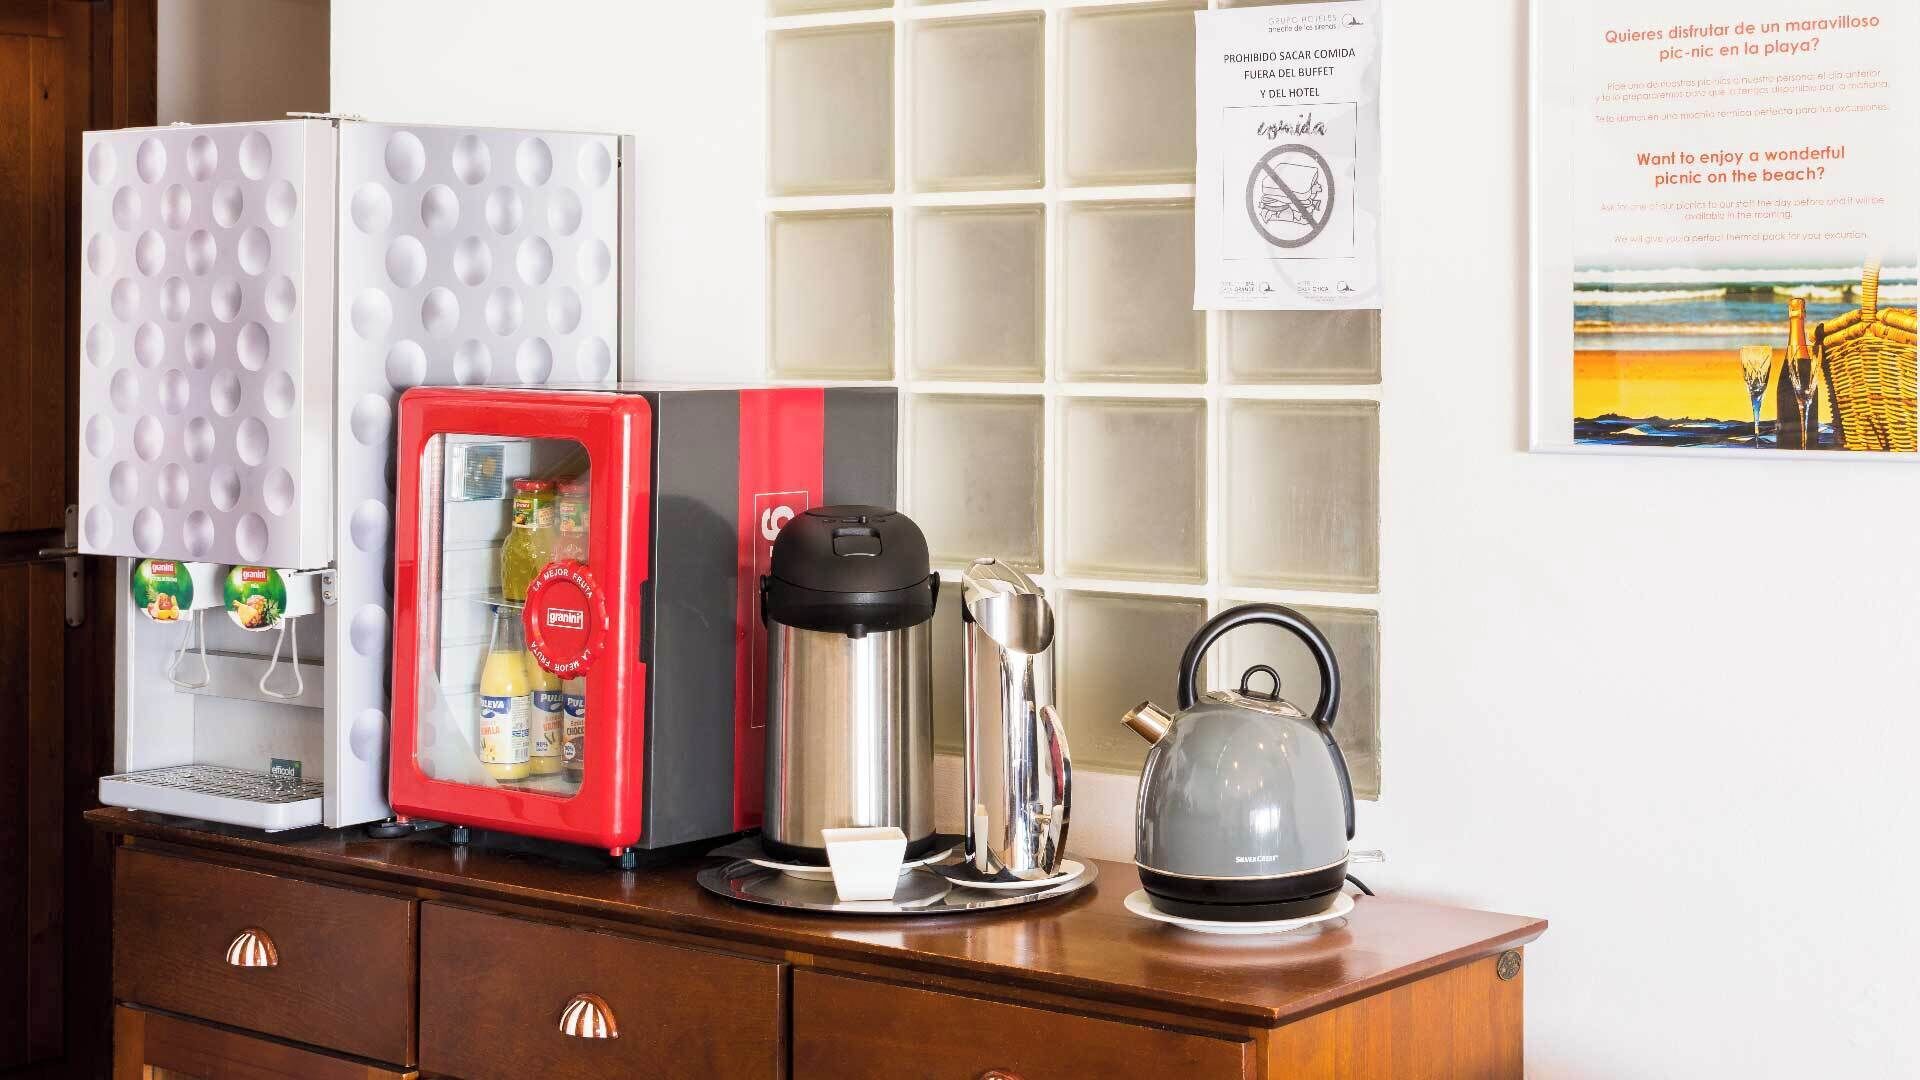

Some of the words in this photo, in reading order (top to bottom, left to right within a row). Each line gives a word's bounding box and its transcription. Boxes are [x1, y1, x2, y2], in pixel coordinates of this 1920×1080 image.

[1605, 28, 1663, 43] Quieres
[1668, 24, 1730, 40] disfrutar
[1734, 22, 1755, 35] de
[1761, 22, 1780, 33] un
[1785, 15, 1880, 32] maravilloso
[1224, 53, 1277, 64] PROHIBIDO
[1279, 50, 1311, 61] SACAR
[1314, 48, 1356, 60] COMIDA
[1659, 43, 1714, 62] pic-nic
[1719, 45, 1739, 56] en
[1744, 41, 1759, 55] la
[1764, 38, 1820, 57] playa?
[1244, 70, 1276, 80] FUERA
[1278, 68, 1295, 78] DEL
[1299, 67, 1334, 77] BUFFET
[1260, 89, 1266, 99] Y
[1269, 88, 1286, 98] DEL
[1289, 87, 1320, 98] HOTEL
[1637, 151, 1676, 166] Want
[1680, 152, 1695, 164] to
[1700, 150, 1744, 167] enjoy
[1749, 151, 1760, 162] a
[1764, 145, 1845, 161] wonderful
[1655, 170, 1702, 188] picnic
[1708, 171, 1727, 183] on
[1732, 169, 1757, 183] the
[1762, 167, 1825, 182] beach?
[243, 570, 266, 580] granini
[533, 581, 542, 592] LA
[543, 568, 569, 580] MEJOR
[572, 572, 593, 599] FRUTA
[549, 611, 580, 624] granini
